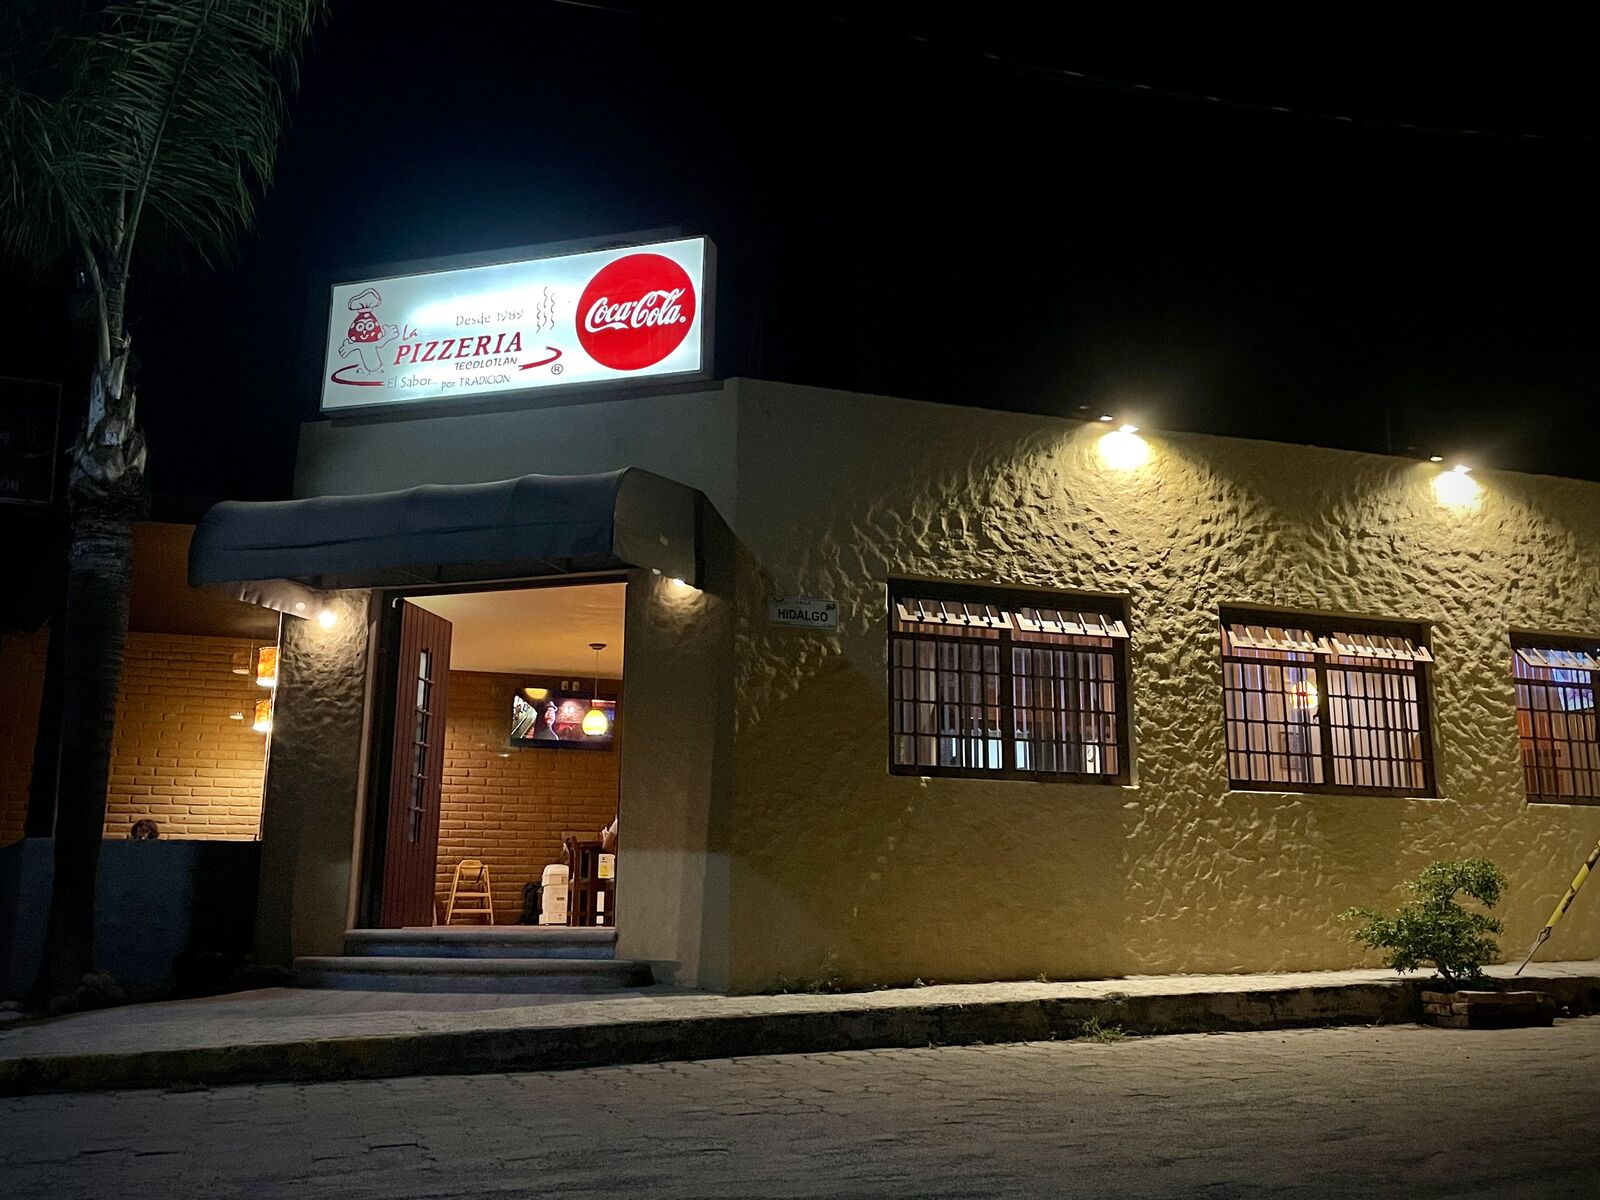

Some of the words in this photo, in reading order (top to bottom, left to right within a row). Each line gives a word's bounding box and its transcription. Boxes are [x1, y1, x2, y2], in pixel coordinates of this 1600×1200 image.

[585, 288, 686, 333] Coca-Cola
[456, 312, 491, 327] Desde
[402, 323, 419, 341] La
[393, 331, 522, 366] PIZZERIA
[454, 357, 518, 371] TECOLOTLAN
[387, 376, 397, 389] El
[441, 381, 456, 391] por
[778, 608, 829, 622] HIDALGO
